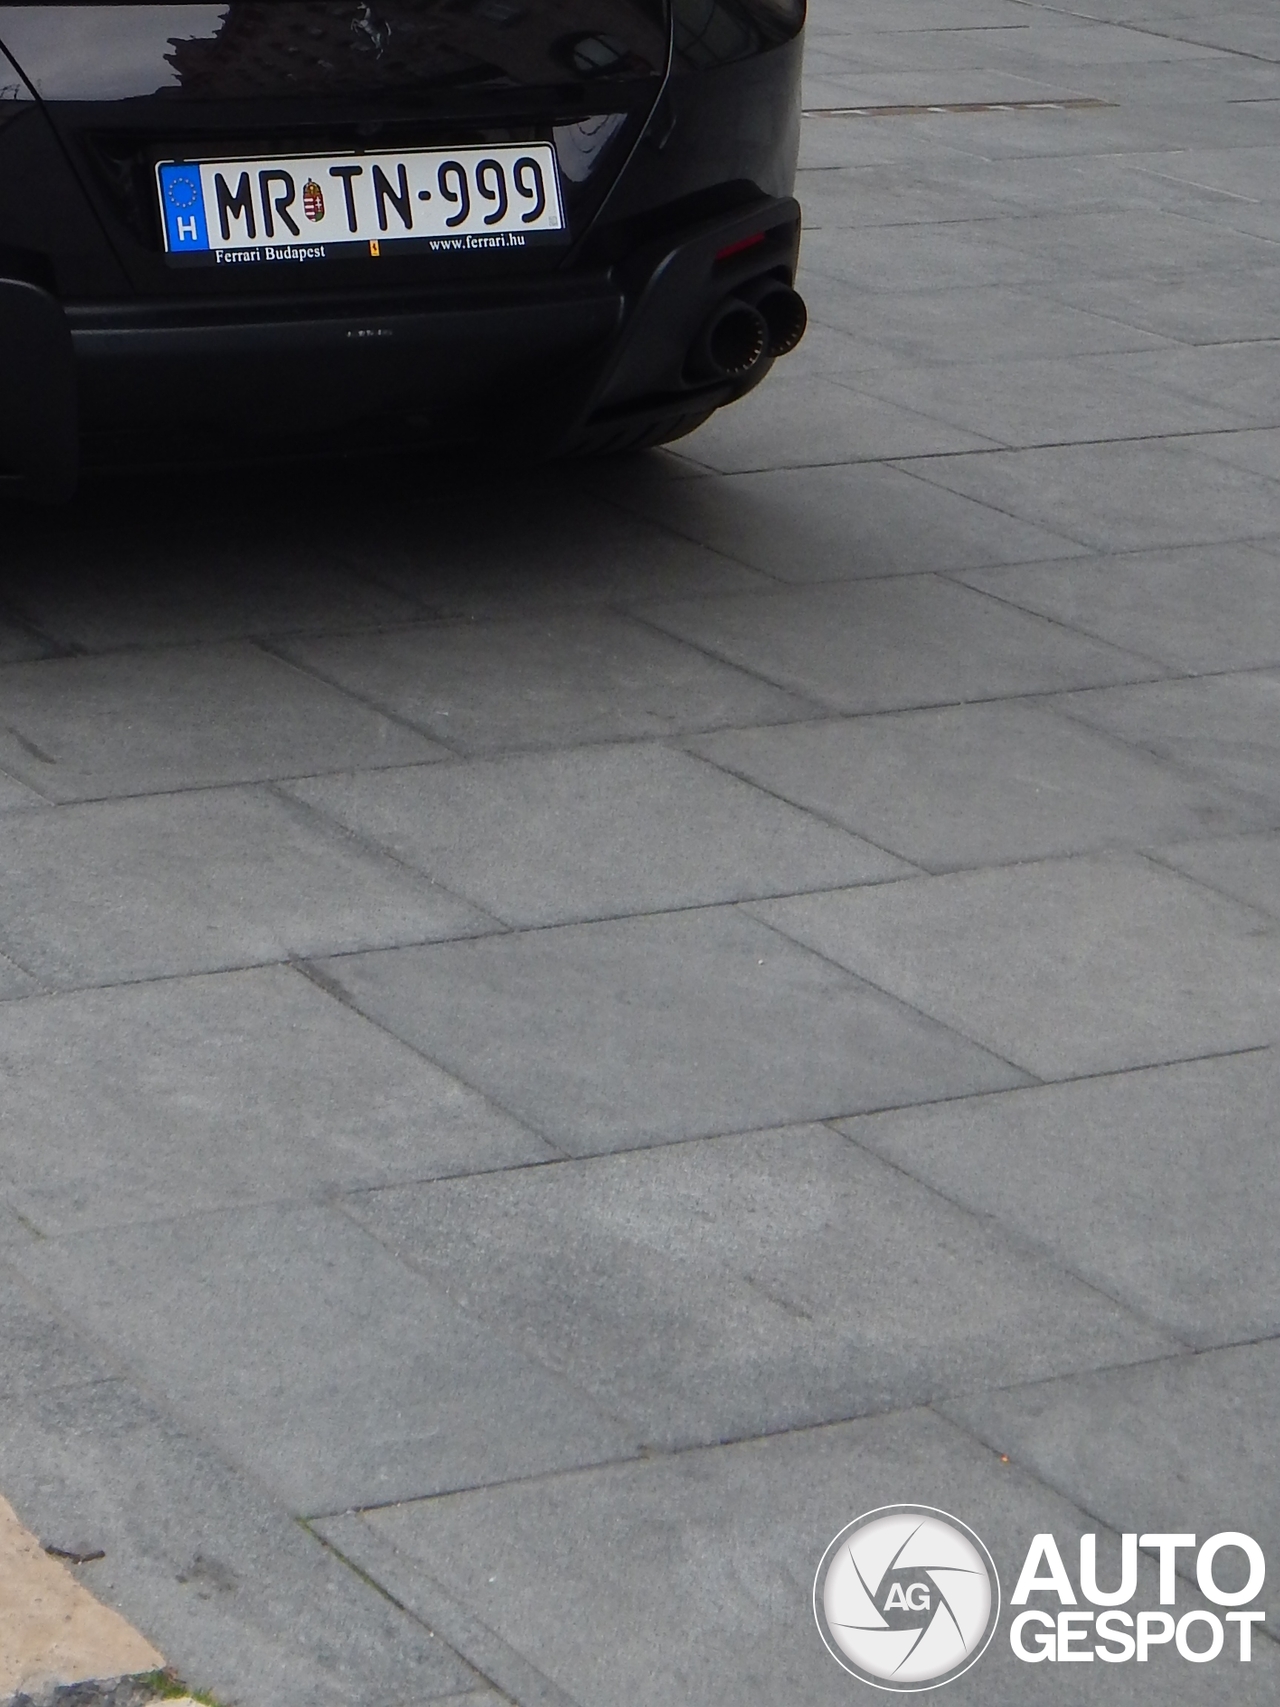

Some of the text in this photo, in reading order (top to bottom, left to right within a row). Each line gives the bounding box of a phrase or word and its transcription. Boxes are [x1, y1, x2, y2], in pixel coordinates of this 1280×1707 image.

[177, 157, 546, 241] H MR TN-999
[429, 233, 526, 251] www.ferrari.hu
[215, 245, 326, 263] Ferrari Budapest
